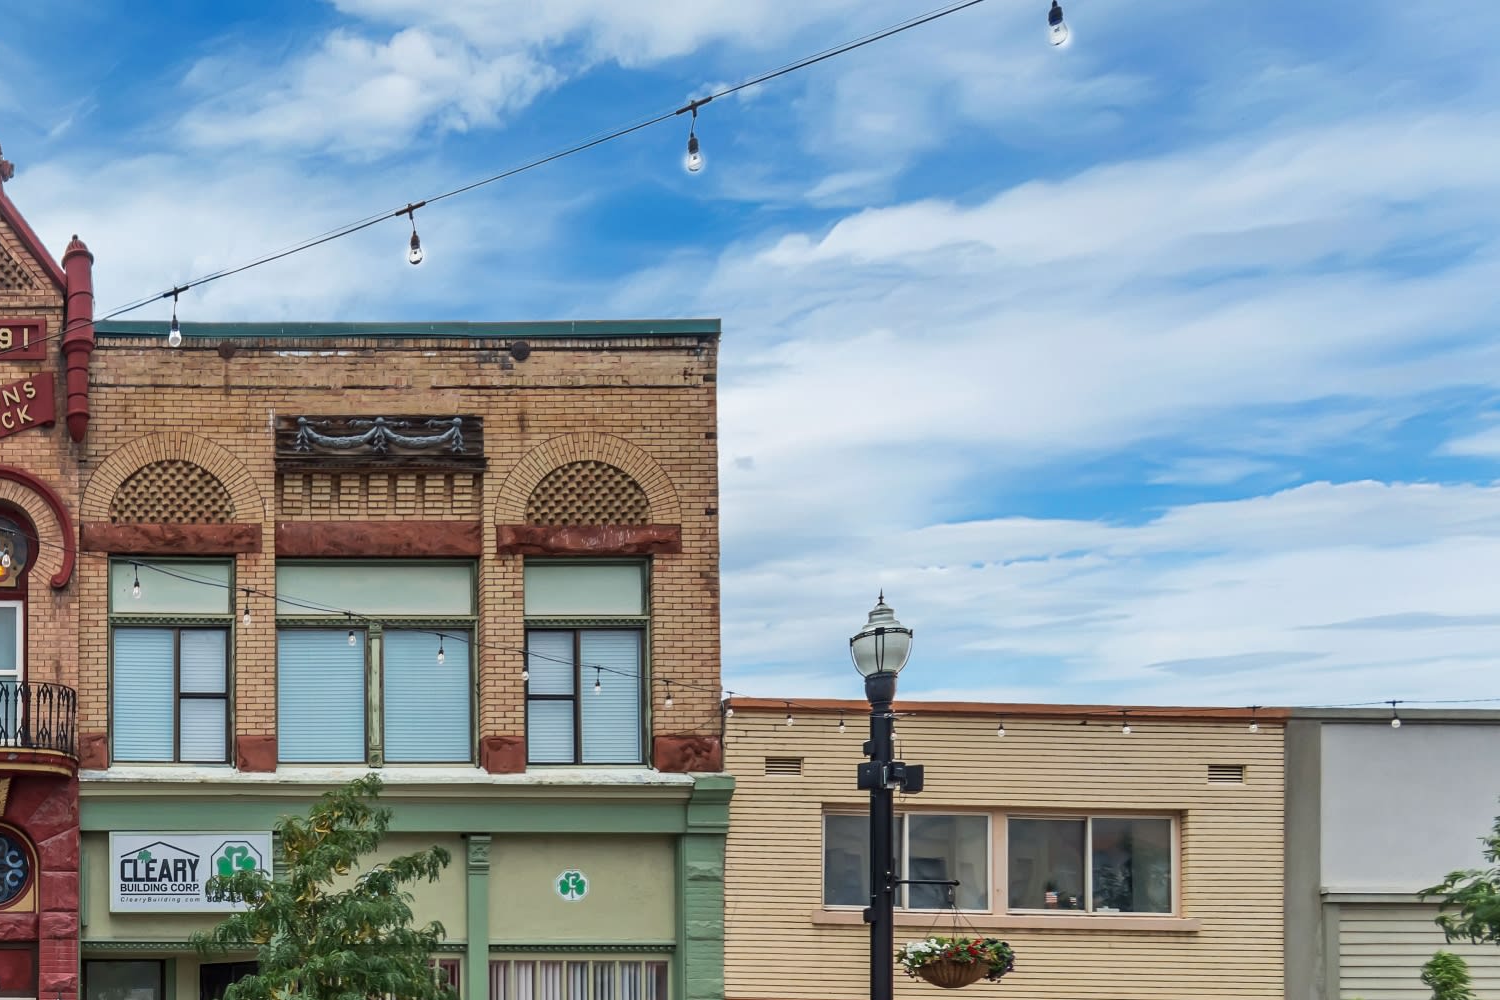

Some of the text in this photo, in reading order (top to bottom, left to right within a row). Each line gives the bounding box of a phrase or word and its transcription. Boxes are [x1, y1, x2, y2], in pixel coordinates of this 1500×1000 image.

[120, 858, 200, 882] CLEARY
[120, 883, 200, 892] BUILDING CORP.
[120, 896, 200, 904] ClearyBuilding.com
